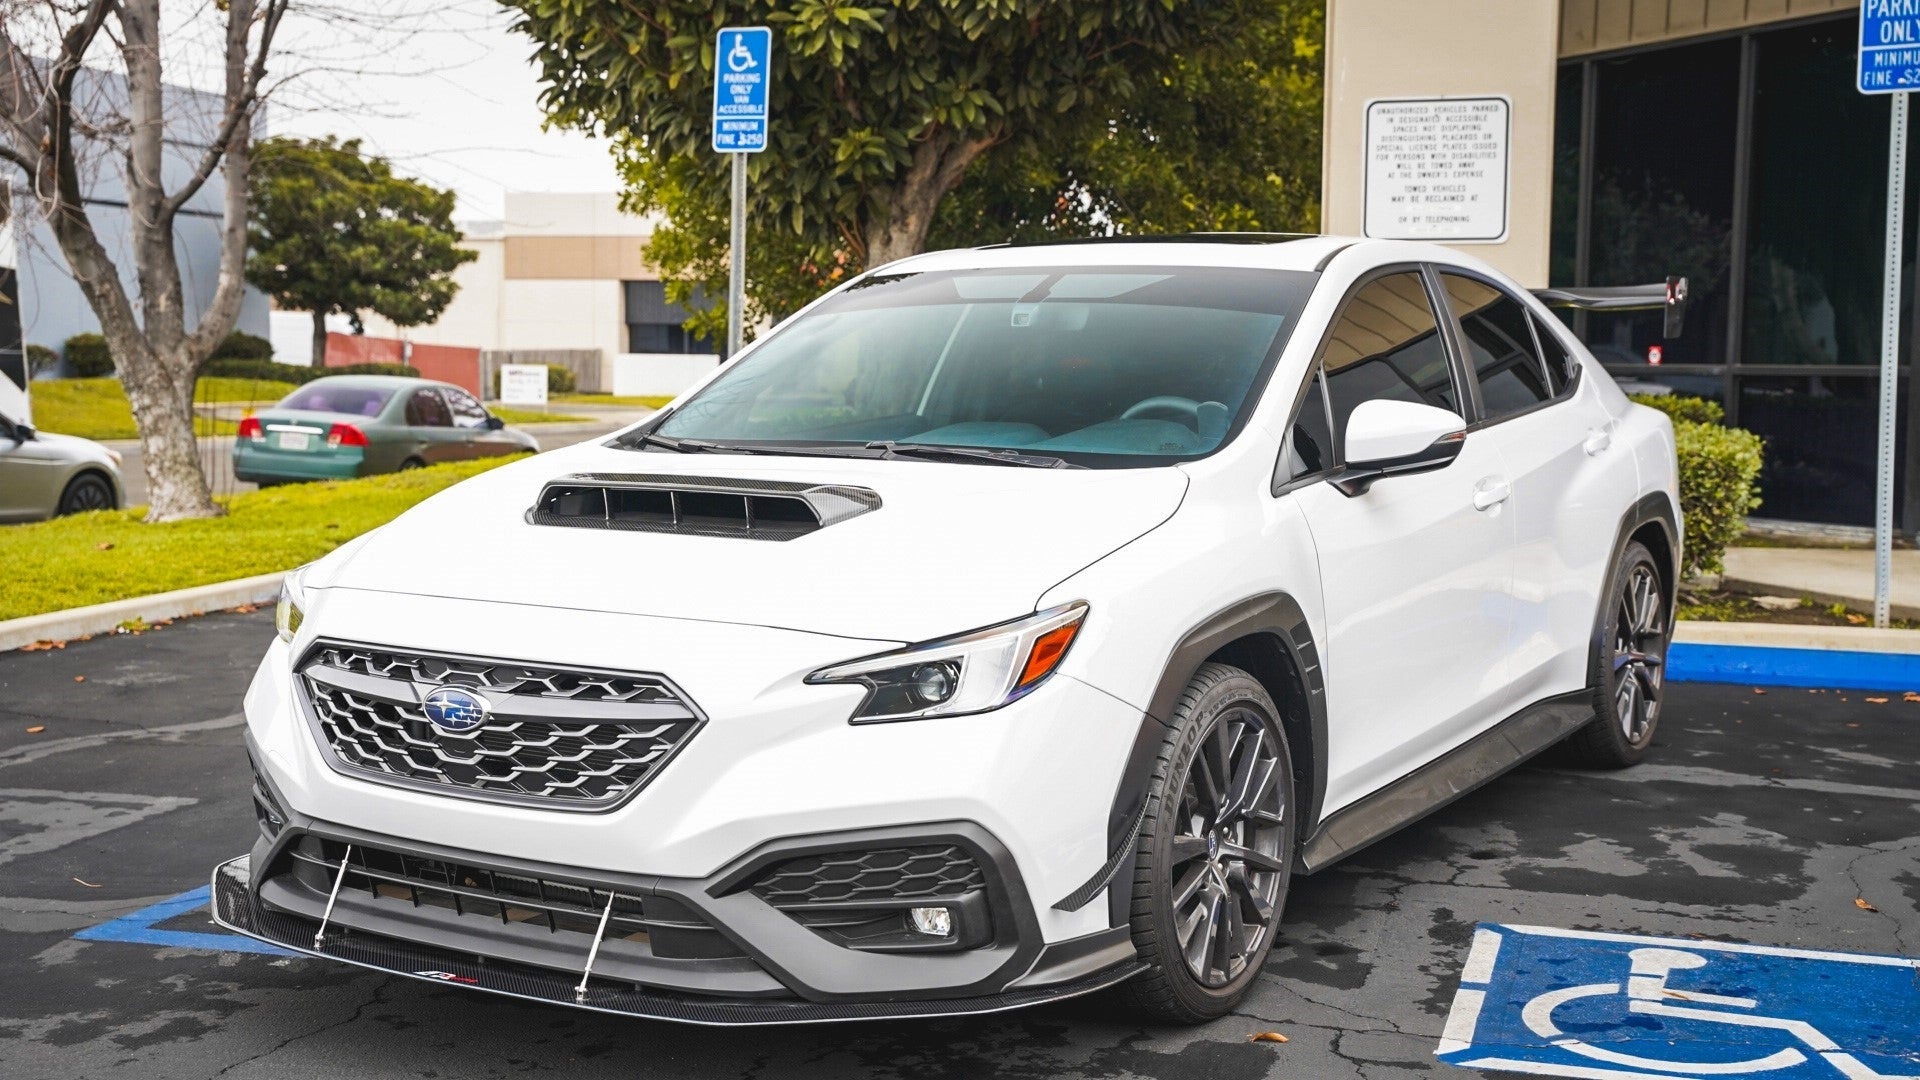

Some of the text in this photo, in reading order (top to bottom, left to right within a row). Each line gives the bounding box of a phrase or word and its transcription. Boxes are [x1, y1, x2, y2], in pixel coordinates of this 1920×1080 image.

[1867, 0, 1919, 18] PARKI
[1875, 50, 1920, 66] MINIMU
[723, 73, 761, 83] PARKING
[1863, 68, 1920, 86] FINE $2
[730, 84, 752, 94] ONLY
[734, 95, 749, 103] VAN
[719, 104, 763, 114] ACCESSIBLE
[722, 121, 758, 131] MINIMUM
[717, 133, 735, 145] FINE
[1165, 711, 1203, 814] DUNLOP
